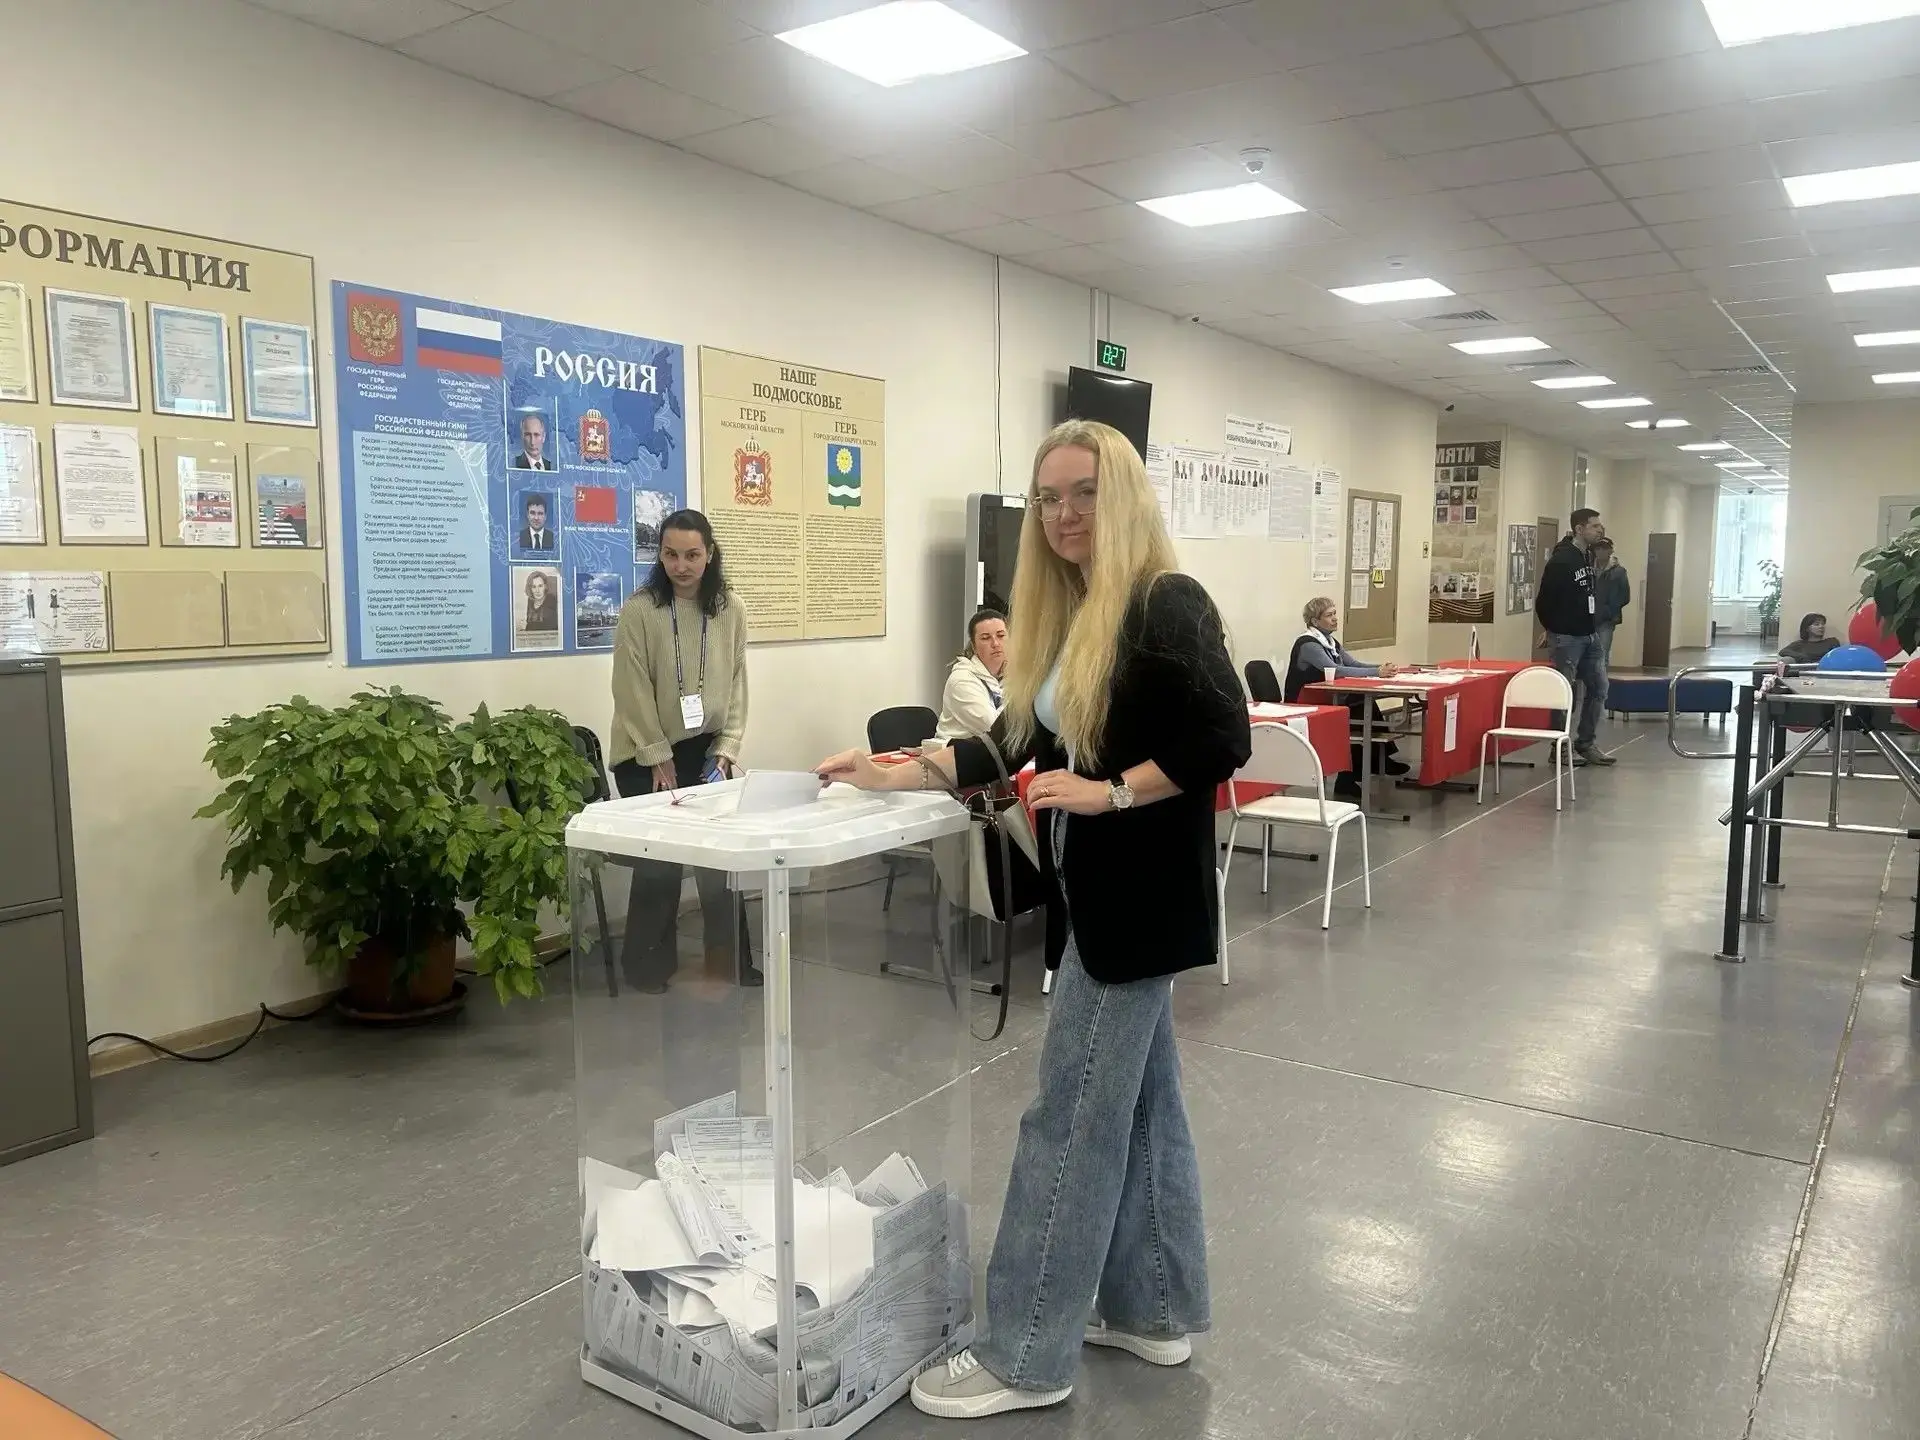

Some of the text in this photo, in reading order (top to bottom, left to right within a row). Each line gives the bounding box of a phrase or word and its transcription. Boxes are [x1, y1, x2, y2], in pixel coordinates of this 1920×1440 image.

[347, 366, 407, 379] ГОСУДАРСТВЕННЫЙ
[534, 346, 659, 396] РОССИЯ
[780, 367, 817, 387] НАШЕ
[358, 382, 398, 392] РОССИЙСКОЙ
[438, 378, 491, 390] ГОСУДАРСТВЕННЫЙ
[360, 390, 397, 400] ФЕДЕРАЦИИ
[447, 394, 482, 404] РОССИЙСКОЙ
[752, 383, 842, 410] ПОДМОСКОВЬЕ
[739, 407, 766, 422] ГЕРБ
[374, 414, 467, 430] ГОСУДАРСТВЕННЫЙ ГИМН
[834, 421, 858, 435] ГЕРБ
[374, 424, 468, 439] РОССИЙСКОЙ ФЕДЕРАЦИИ
